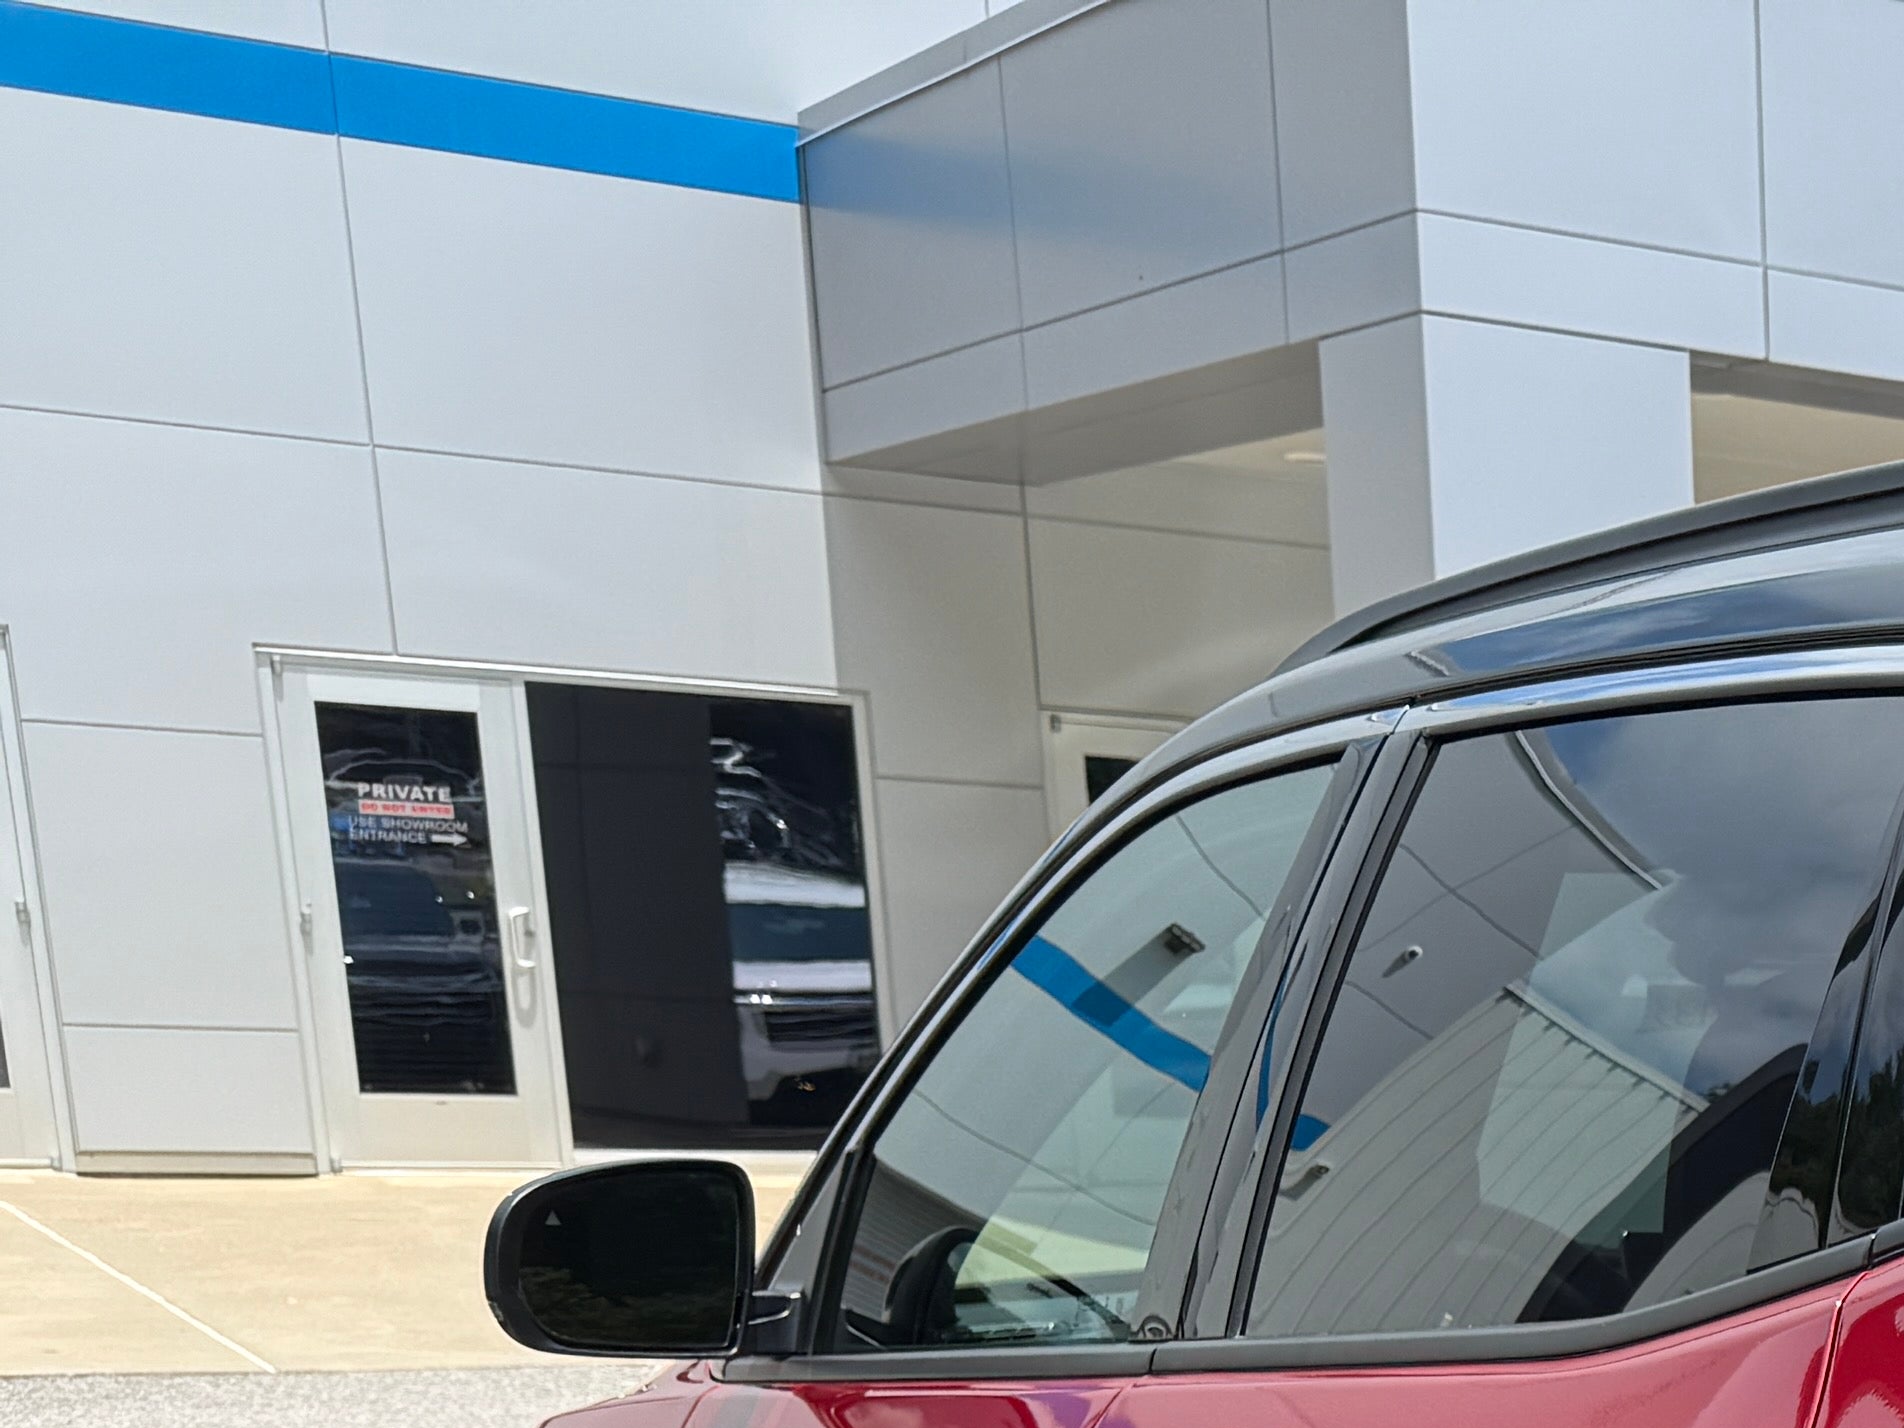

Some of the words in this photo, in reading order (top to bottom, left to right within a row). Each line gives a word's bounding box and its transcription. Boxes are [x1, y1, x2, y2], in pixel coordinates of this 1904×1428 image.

[358, 782, 451, 803] PRIVATE
[349, 815, 377, 829] USE
[381, 817, 468, 833] SHOWROOM
[350, 829, 427, 844] ENTRANCE
